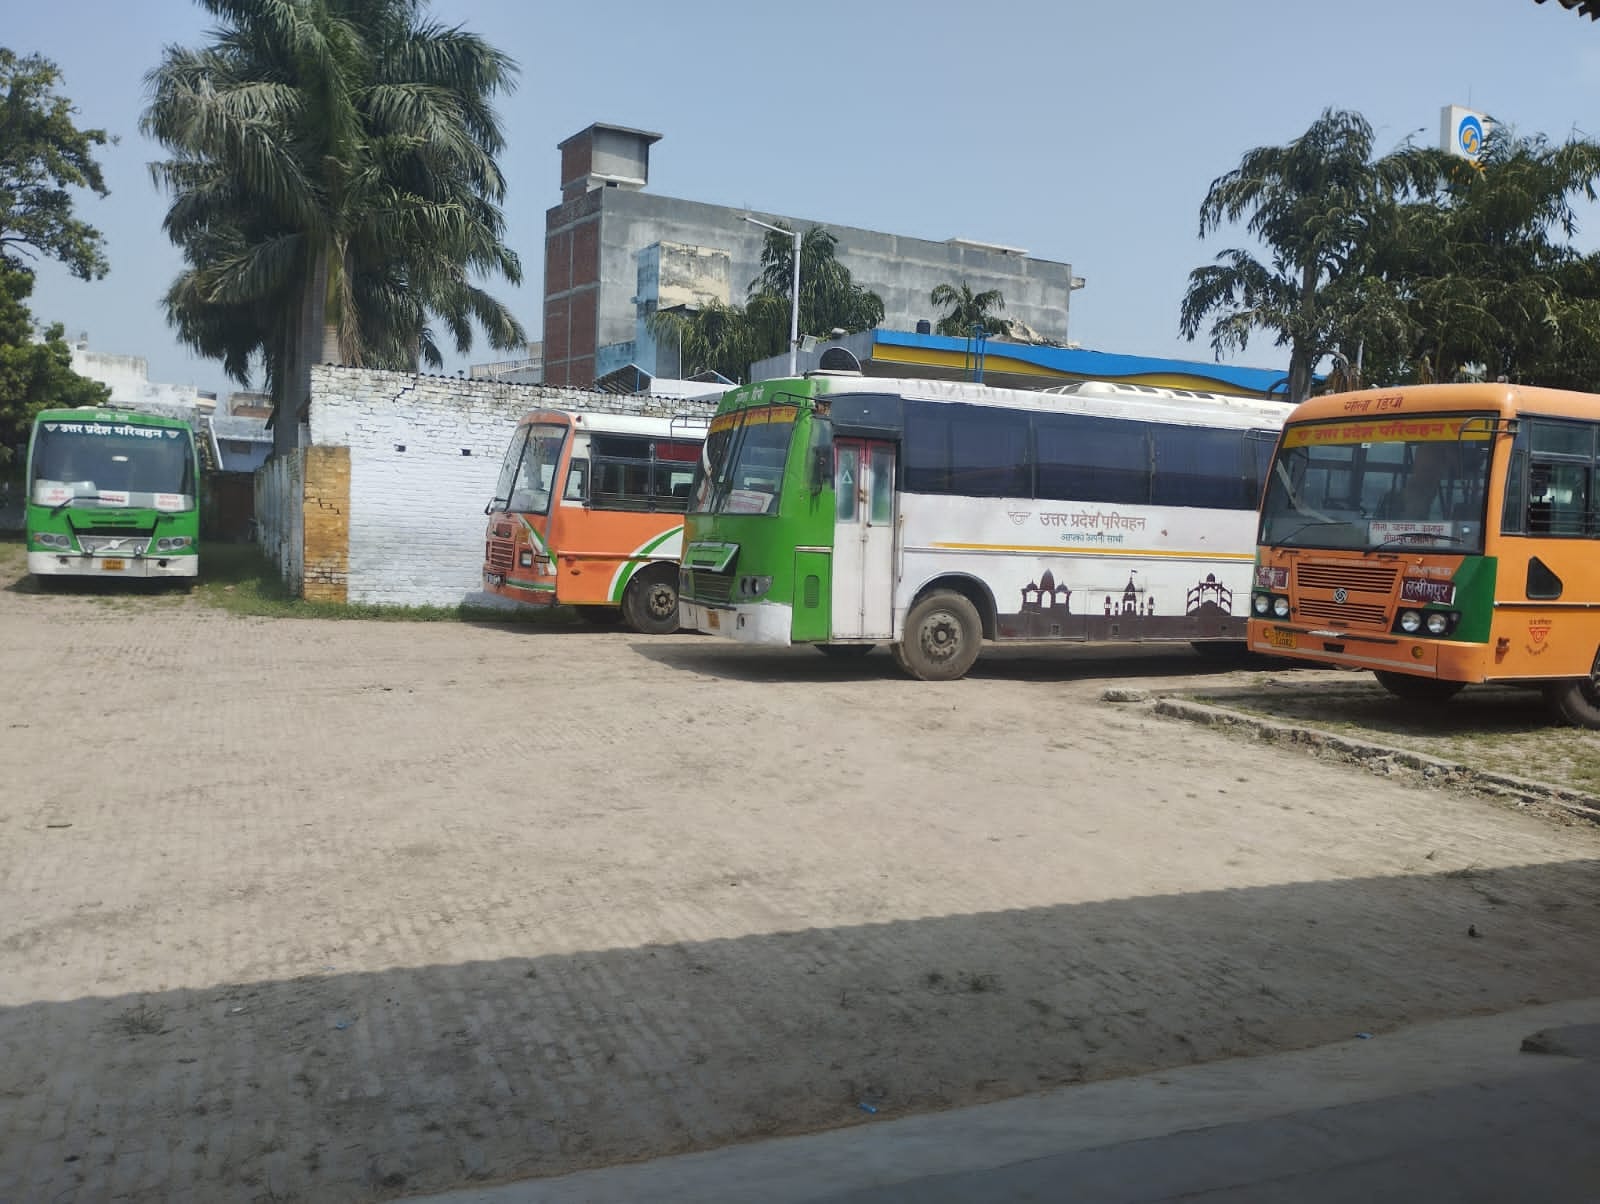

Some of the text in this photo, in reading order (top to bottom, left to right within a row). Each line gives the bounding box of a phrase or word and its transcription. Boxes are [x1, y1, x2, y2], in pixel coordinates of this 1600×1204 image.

[59, 422, 163, 438] उत्तर प्रदेश परिवहन
[1039, 510, 1147, 532] उत्तर प्रदेश परिवहन
